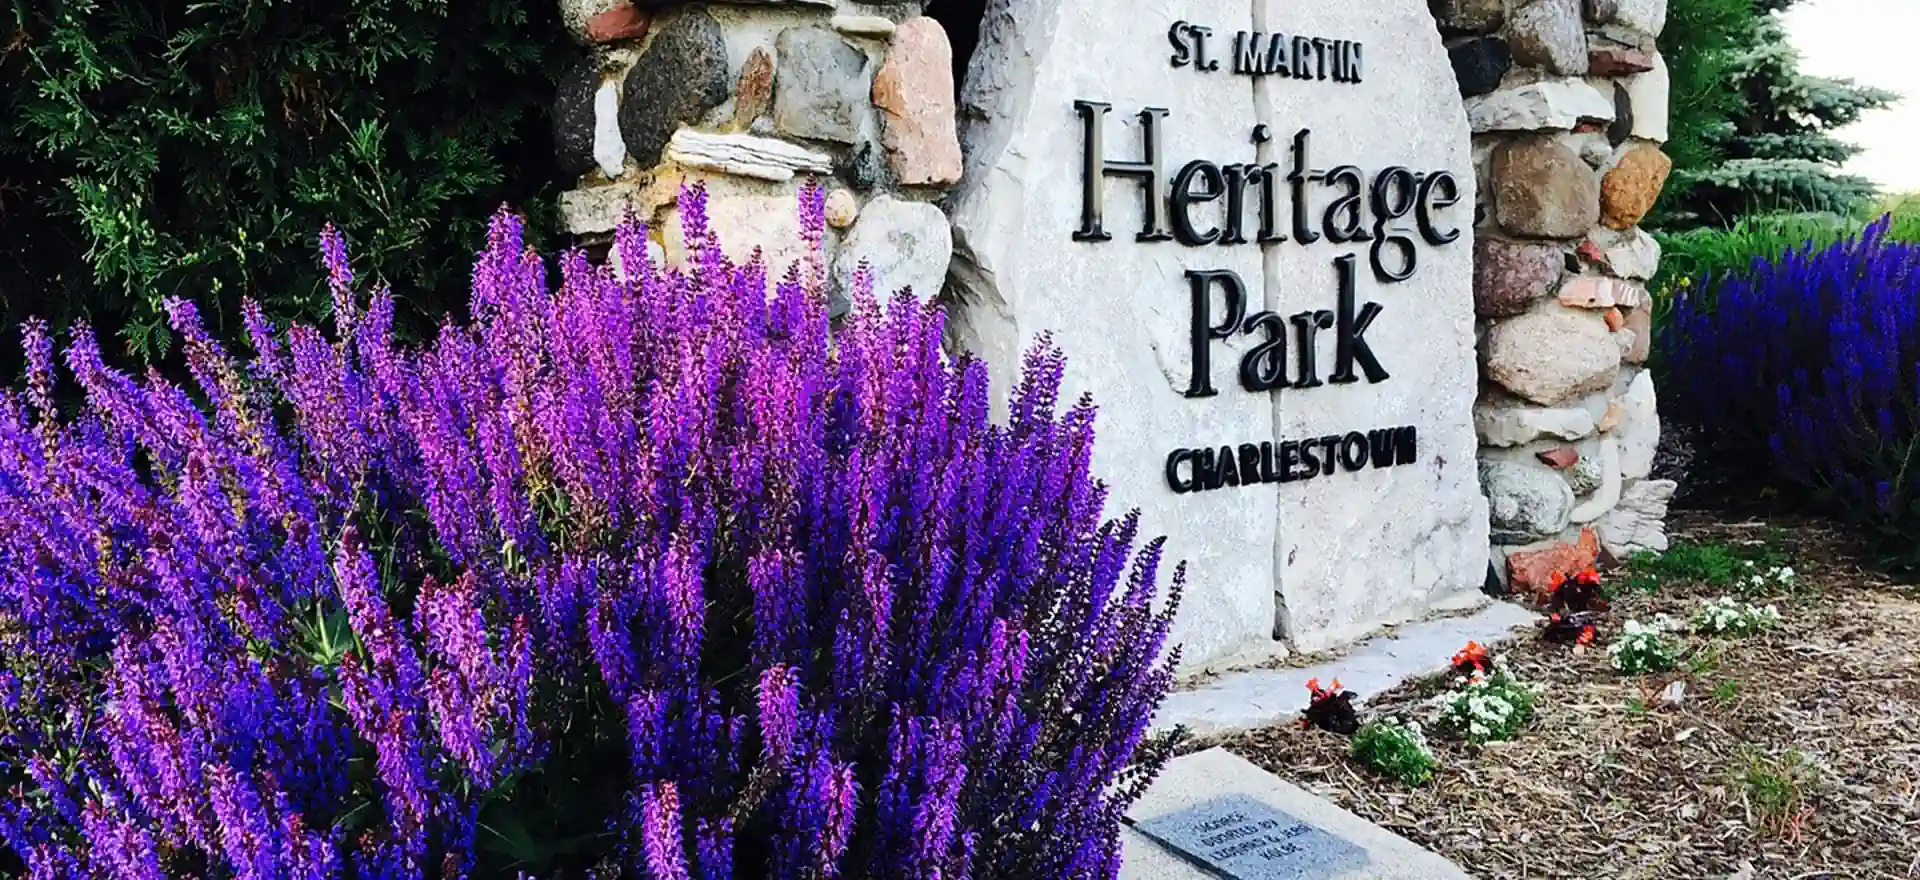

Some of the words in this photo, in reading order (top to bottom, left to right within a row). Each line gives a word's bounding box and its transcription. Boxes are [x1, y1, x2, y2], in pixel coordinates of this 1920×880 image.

[1168, 20, 1219, 71] ST.
[1234, 31, 1363, 83] MARTIN
[1072, 100, 1461, 283] Heritage
[1184, 252, 1390, 398] Park
[1165, 425, 1417, 493] CHARLESTOWN
